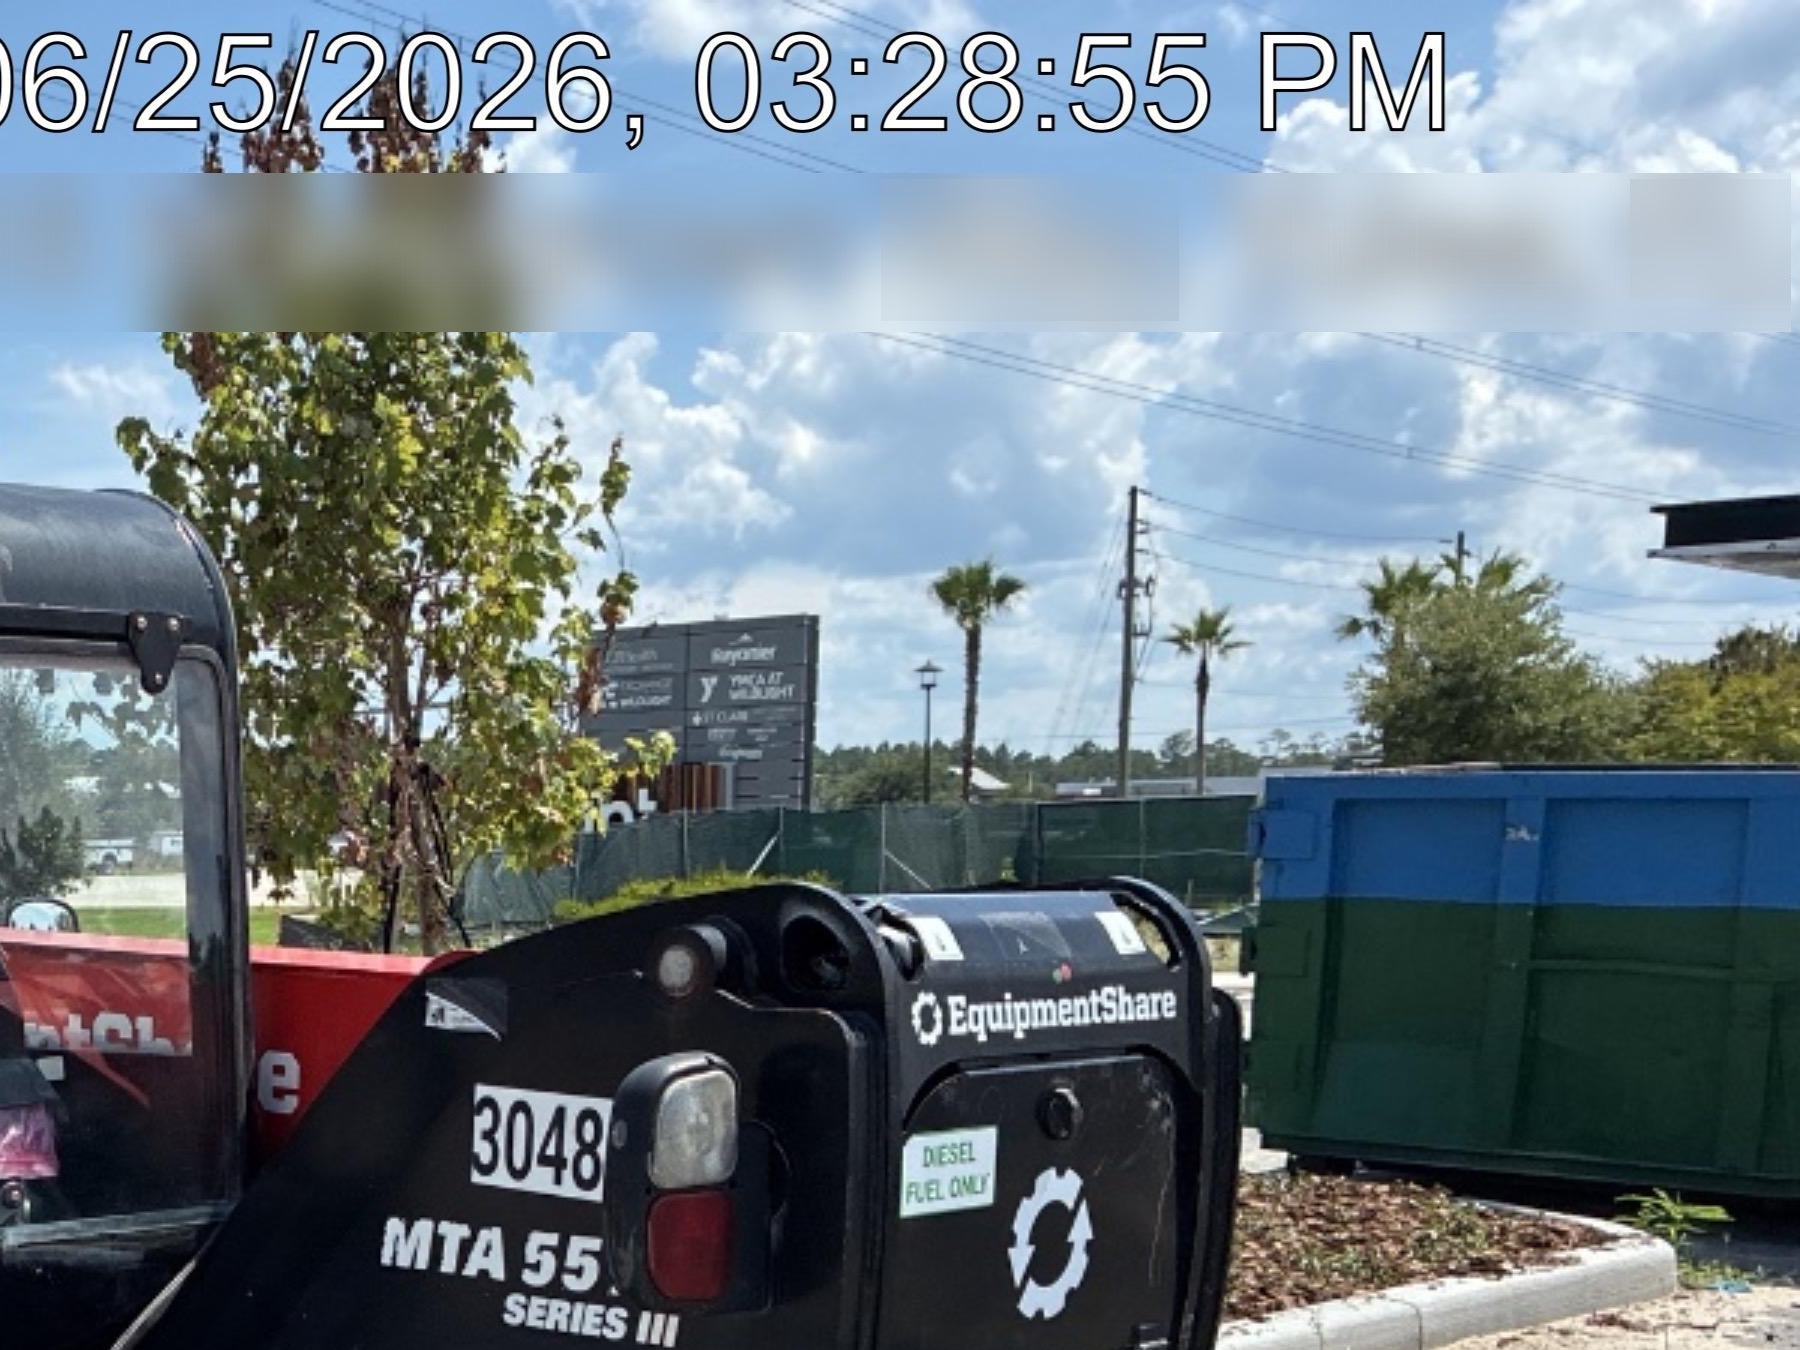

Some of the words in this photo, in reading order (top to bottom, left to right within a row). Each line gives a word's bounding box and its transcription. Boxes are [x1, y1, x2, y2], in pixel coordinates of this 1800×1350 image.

[947, 985, 1178, 1043] EquipmentShare
[471, 1096, 604, 1192] 3048
[922, 1142, 976, 1168] DIESEL
[906, 1179, 946, 1205] FUEL
[950, 1172, 991, 1198] ONLY
[380, 1216, 506, 1282] MTA
[502, 1292, 629, 1341] SERIES
[634, 1310, 681, 1349] III
